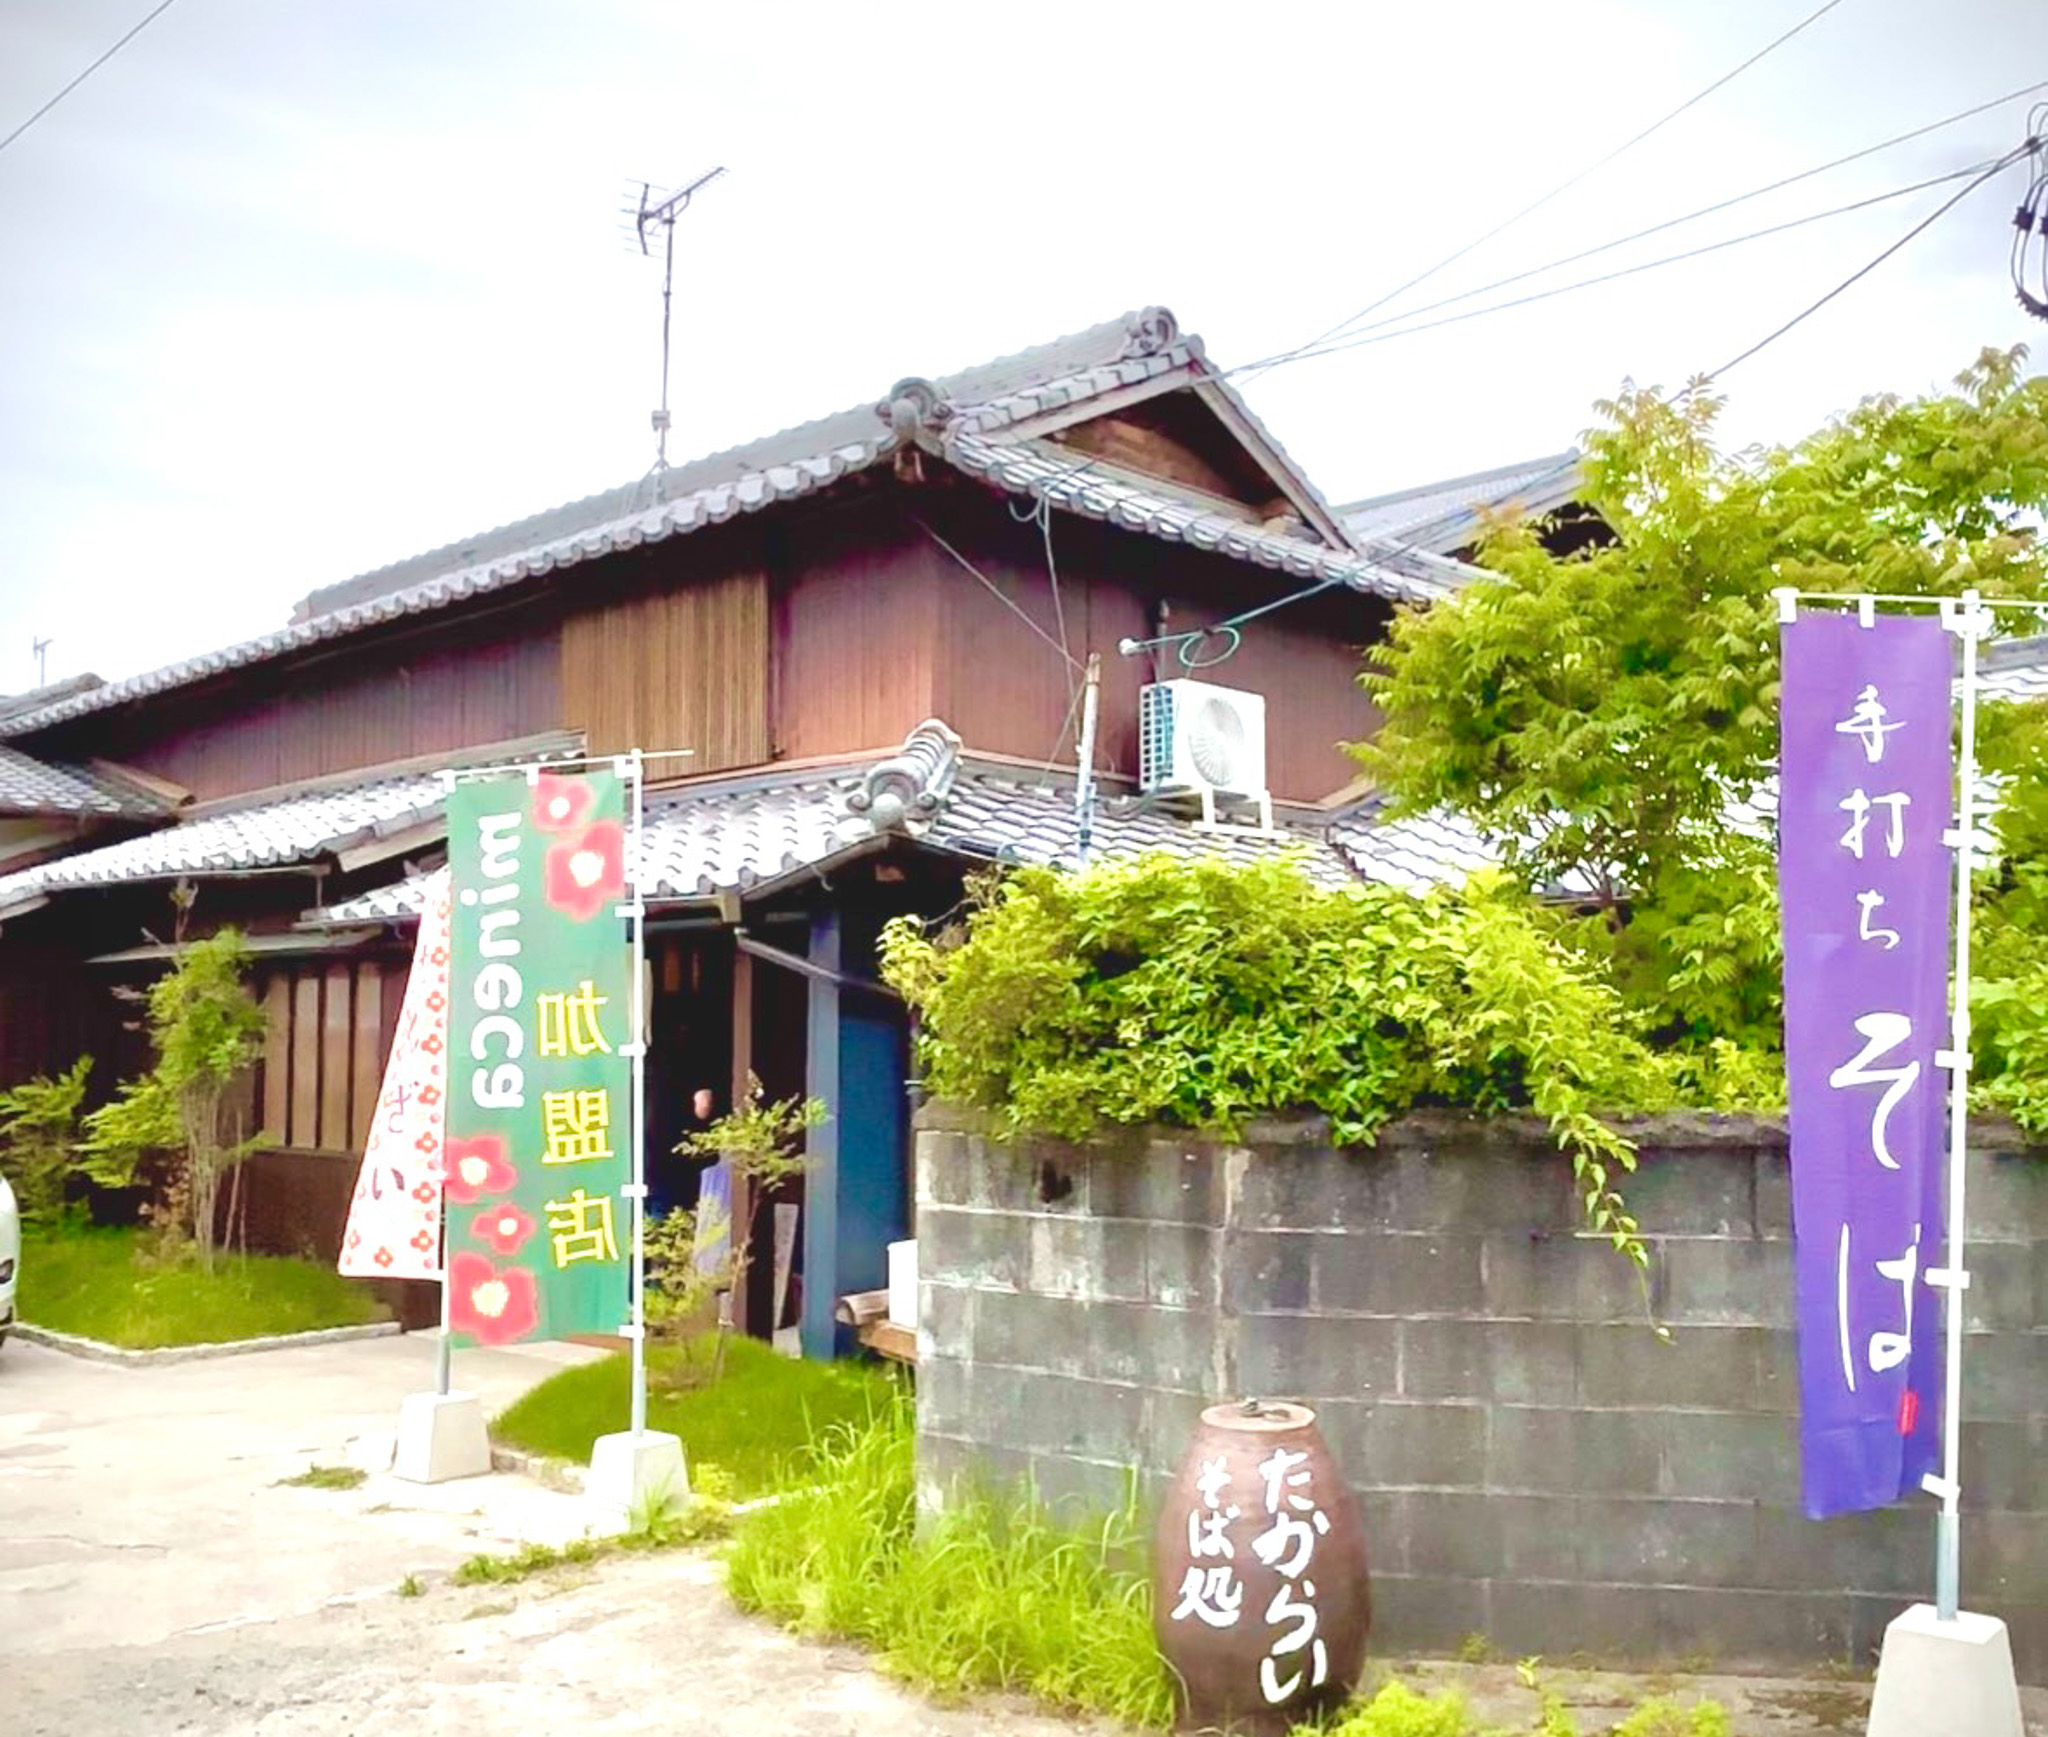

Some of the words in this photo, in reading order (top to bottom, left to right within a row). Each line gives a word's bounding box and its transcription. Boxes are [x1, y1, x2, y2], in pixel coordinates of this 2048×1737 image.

[1171, 1456, 1243, 1628] そば処
[1252, 1448, 1331, 1704] たからい
